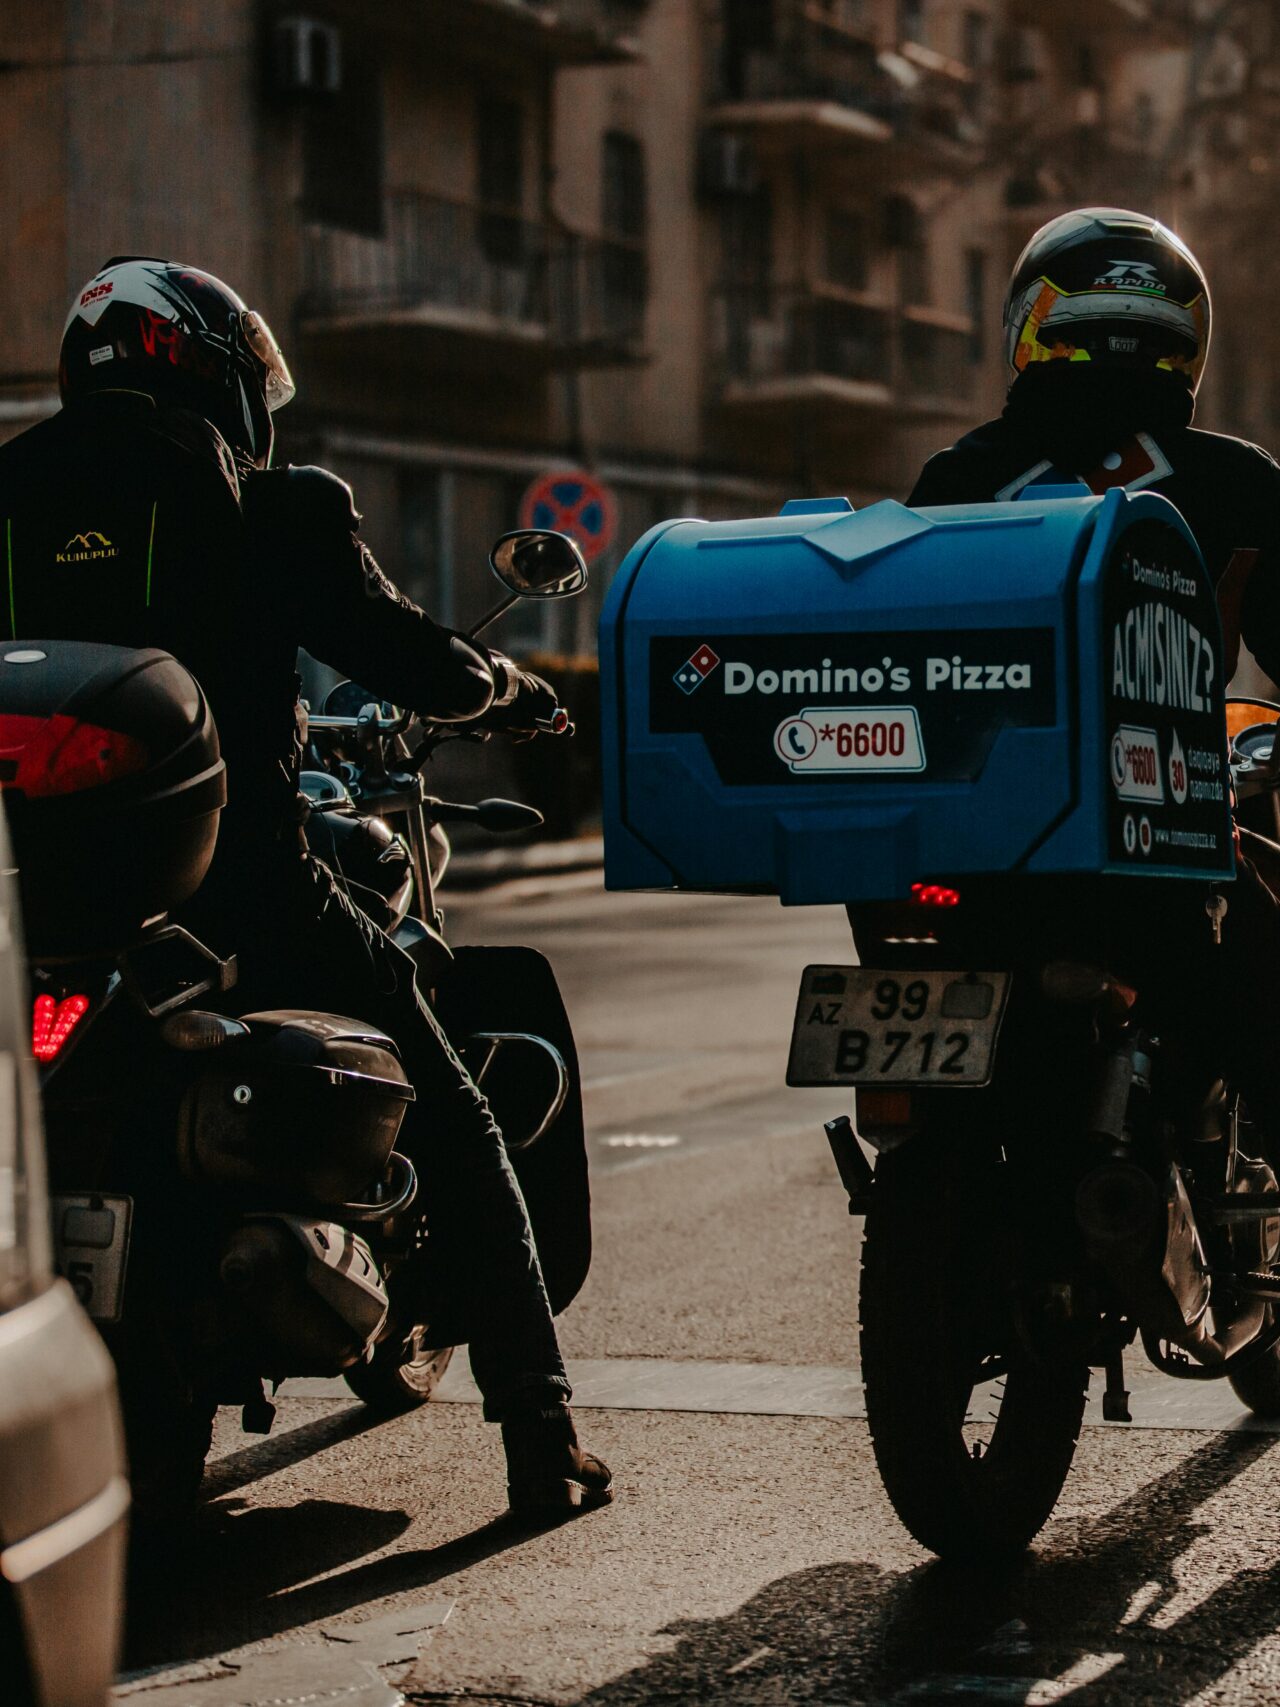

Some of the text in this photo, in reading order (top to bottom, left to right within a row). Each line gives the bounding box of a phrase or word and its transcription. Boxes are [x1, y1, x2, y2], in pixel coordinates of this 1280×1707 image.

[1132, 558, 1196, 597] Domino's Pizza
[724, 656, 1031, 695] Domino's Pizza
[1112, 602, 1214, 713] ACMISINIZ?
[1172, 760, 1185, 792] 30
[807, 1003, 843, 1025] AZ
[871, 979, 929, 1021] 99
